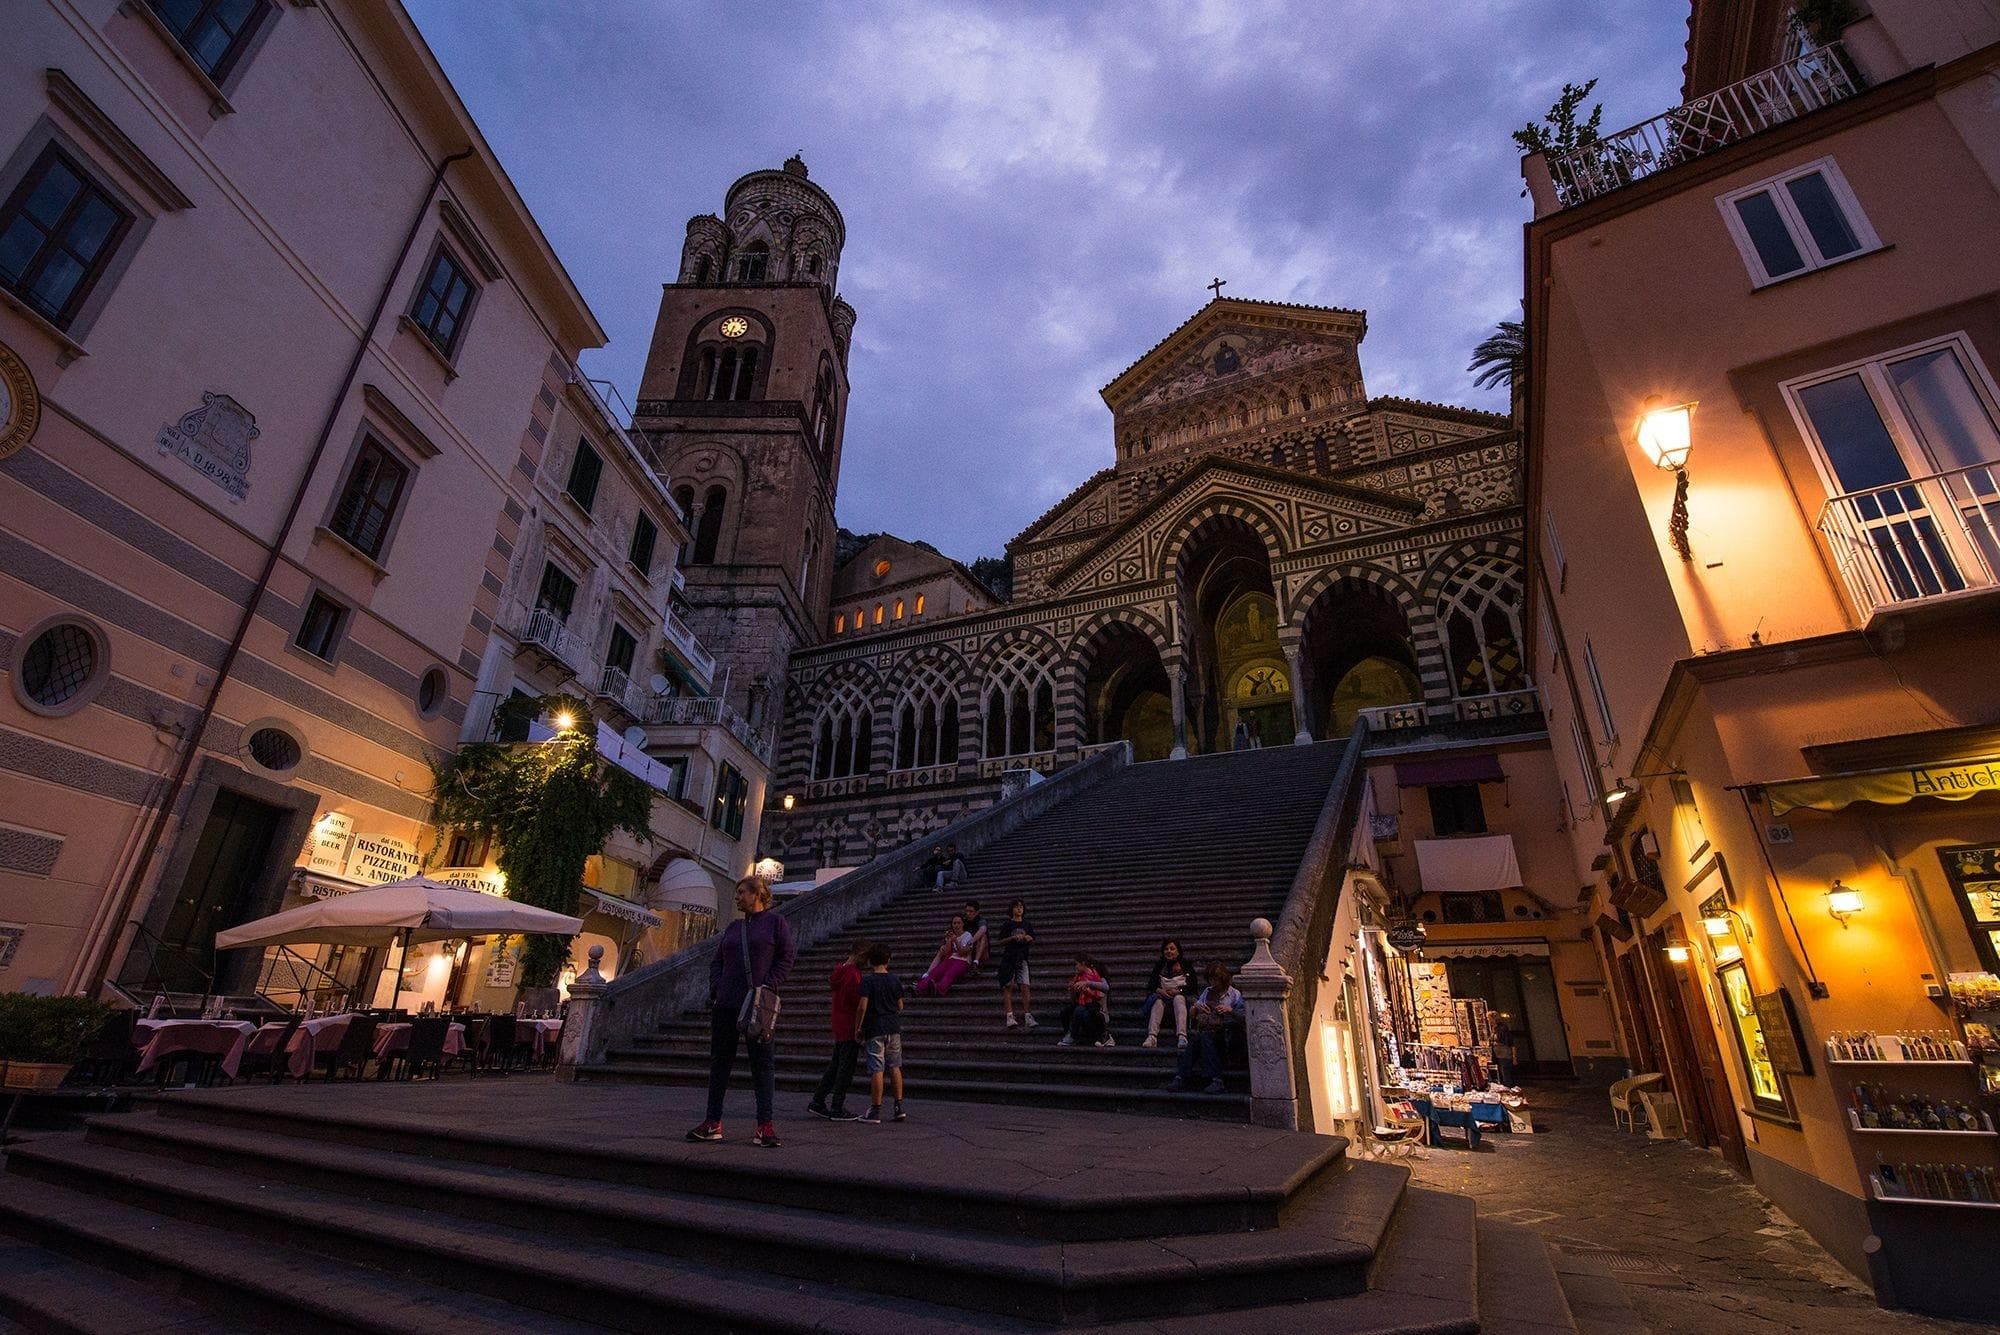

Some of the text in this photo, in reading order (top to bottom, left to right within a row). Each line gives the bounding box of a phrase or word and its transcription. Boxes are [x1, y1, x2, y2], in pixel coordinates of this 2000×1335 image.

[203, 460, 231, 485] 1898
[1909, 766, 2000, 794] Antich
[320, 839, 341, 850] BEER
[357, 838, 419, 865] RISTORANTE
[354, 865, 364, 876] S.
[362, 854, 408, 875] PIZZERIA
[602, 901, 636, 920] RISTORANTE
